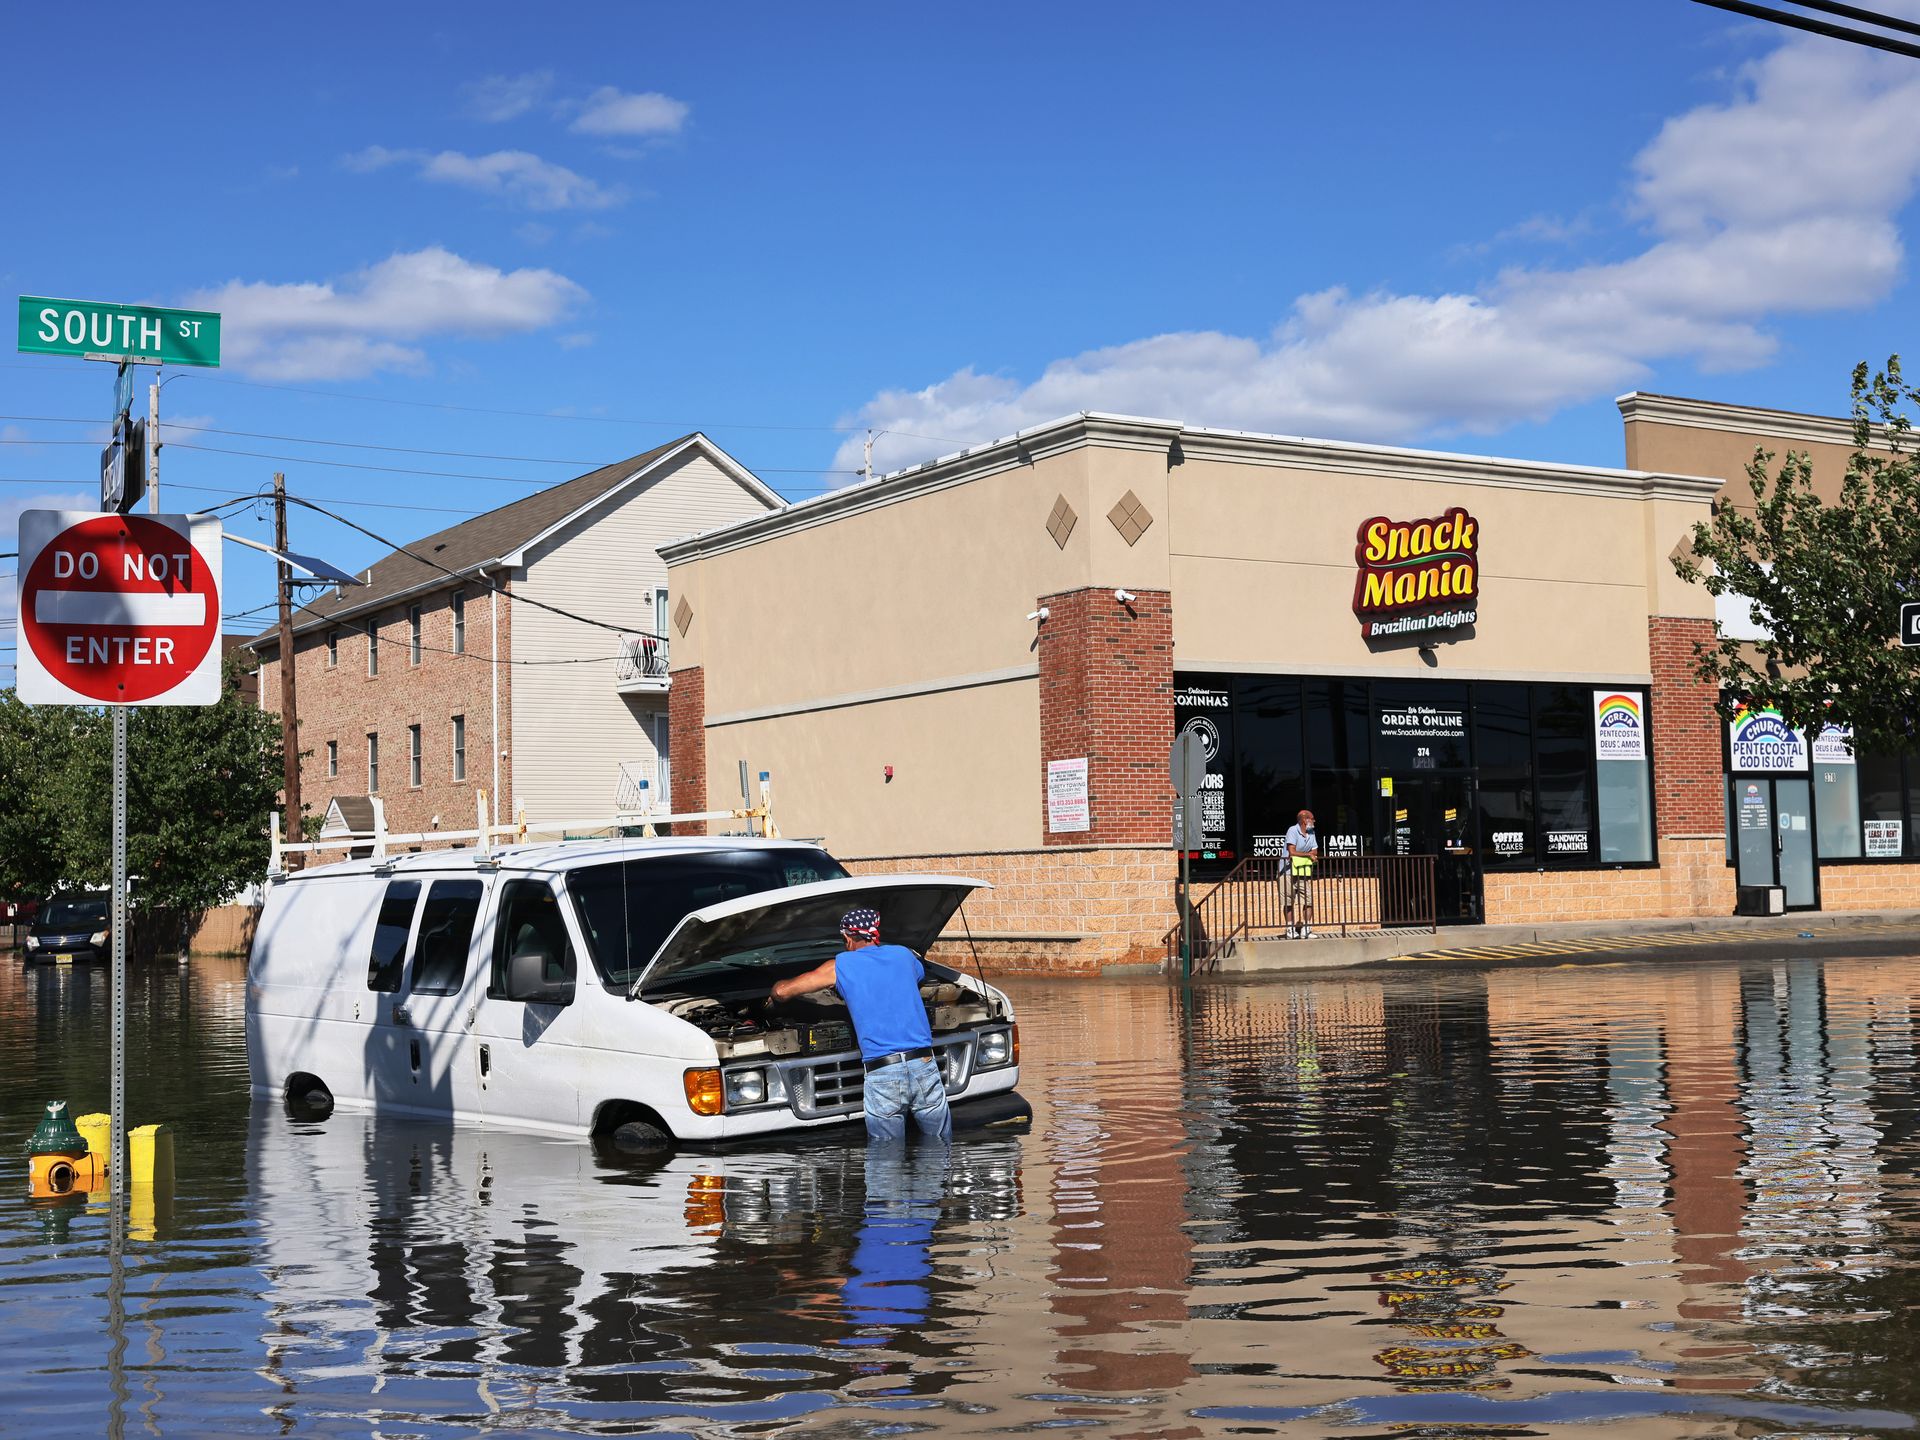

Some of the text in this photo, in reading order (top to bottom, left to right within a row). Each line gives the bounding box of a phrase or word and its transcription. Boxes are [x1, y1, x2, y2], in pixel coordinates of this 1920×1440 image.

[38, 308, 202, 351] SOUTH ST
[1365, 513, 1474, 562] Snack
[54, 551, 190, 582] DO NOT
[1362, 561, 1474, 608] Mania
[1370, 610, 1476, 636] Brazilian Delights
[66, 636, 175, 665] ENTER
[1381, 714, 1463, 727] ORDER ONLINE
[1604, 712, 1634, 727] IGREJA
[1381, 728, 1465, 737] www.SnackManiaFoods.com
[1599, 729, 1641, 738] PENTECOSTAL
[1746, 720, 1789, 742] CHURCH
[1600, 740, 1616, 749] DEUS
[1621, 740, 1641, 749] AMOR
[1733, 742, 1804, 756] PENTECOSTAL
[1417, 747, 1430, 757] 374
[1739, 756, 1795, 768] GOD IS LOVE
[1202, 819, 1225, 827] MUCH
[1492, 832, 1523, 842] COFFEE
[1548, 834, 1588, 842] SANDWICH
[1868, 830, 1882, 838] LEASE
[1886, 830, 1897, 838] RENT
[1253, 838, 1285, 847] JUICES
[1329, 835, 1357, 850] AÇAI
[1501, 842, 1524, 851] CAKES
[1558, 842, 1588, 851] PANINIS
